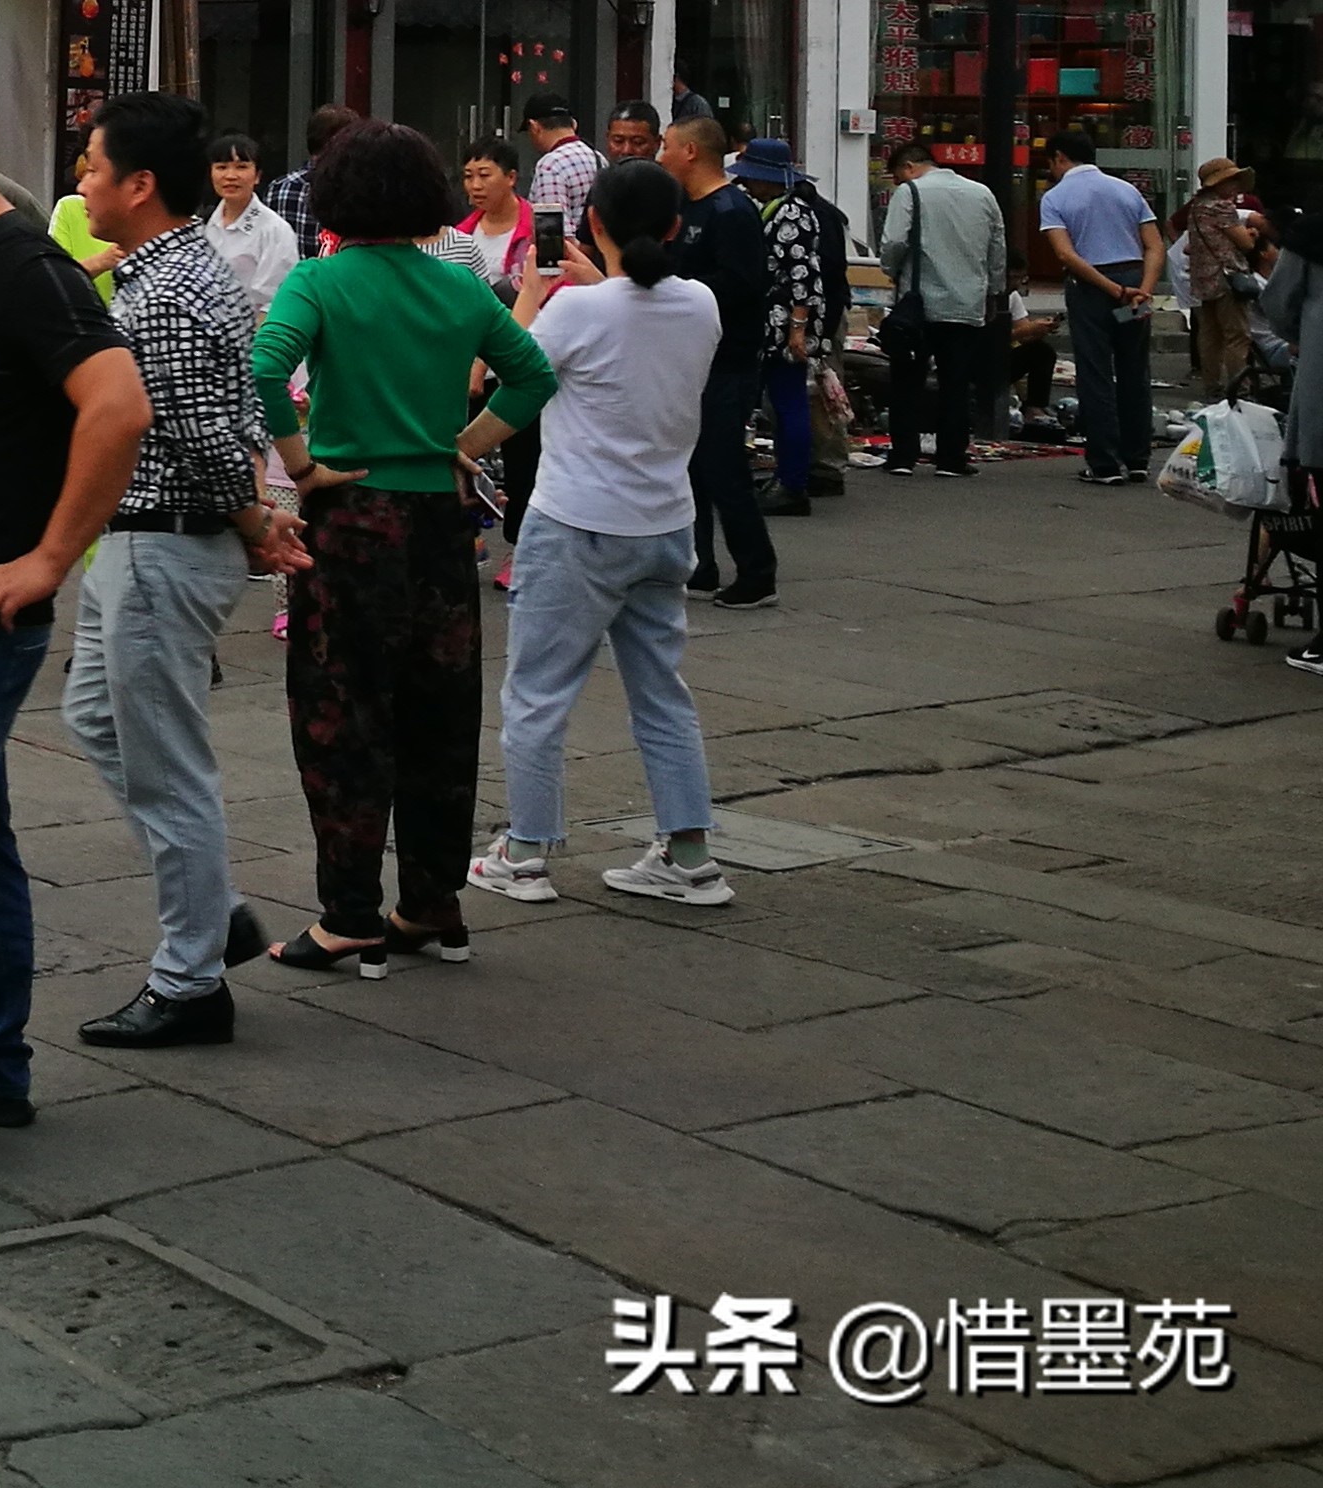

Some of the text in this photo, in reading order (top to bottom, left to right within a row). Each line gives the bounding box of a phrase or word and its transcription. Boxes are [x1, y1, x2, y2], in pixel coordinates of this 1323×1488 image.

[883, 0, 920, 95] 太平猴魁
[1123, 12, 1155, 102] 祁门红茶
[1263, 515, 1314, 532] SPIRIT
